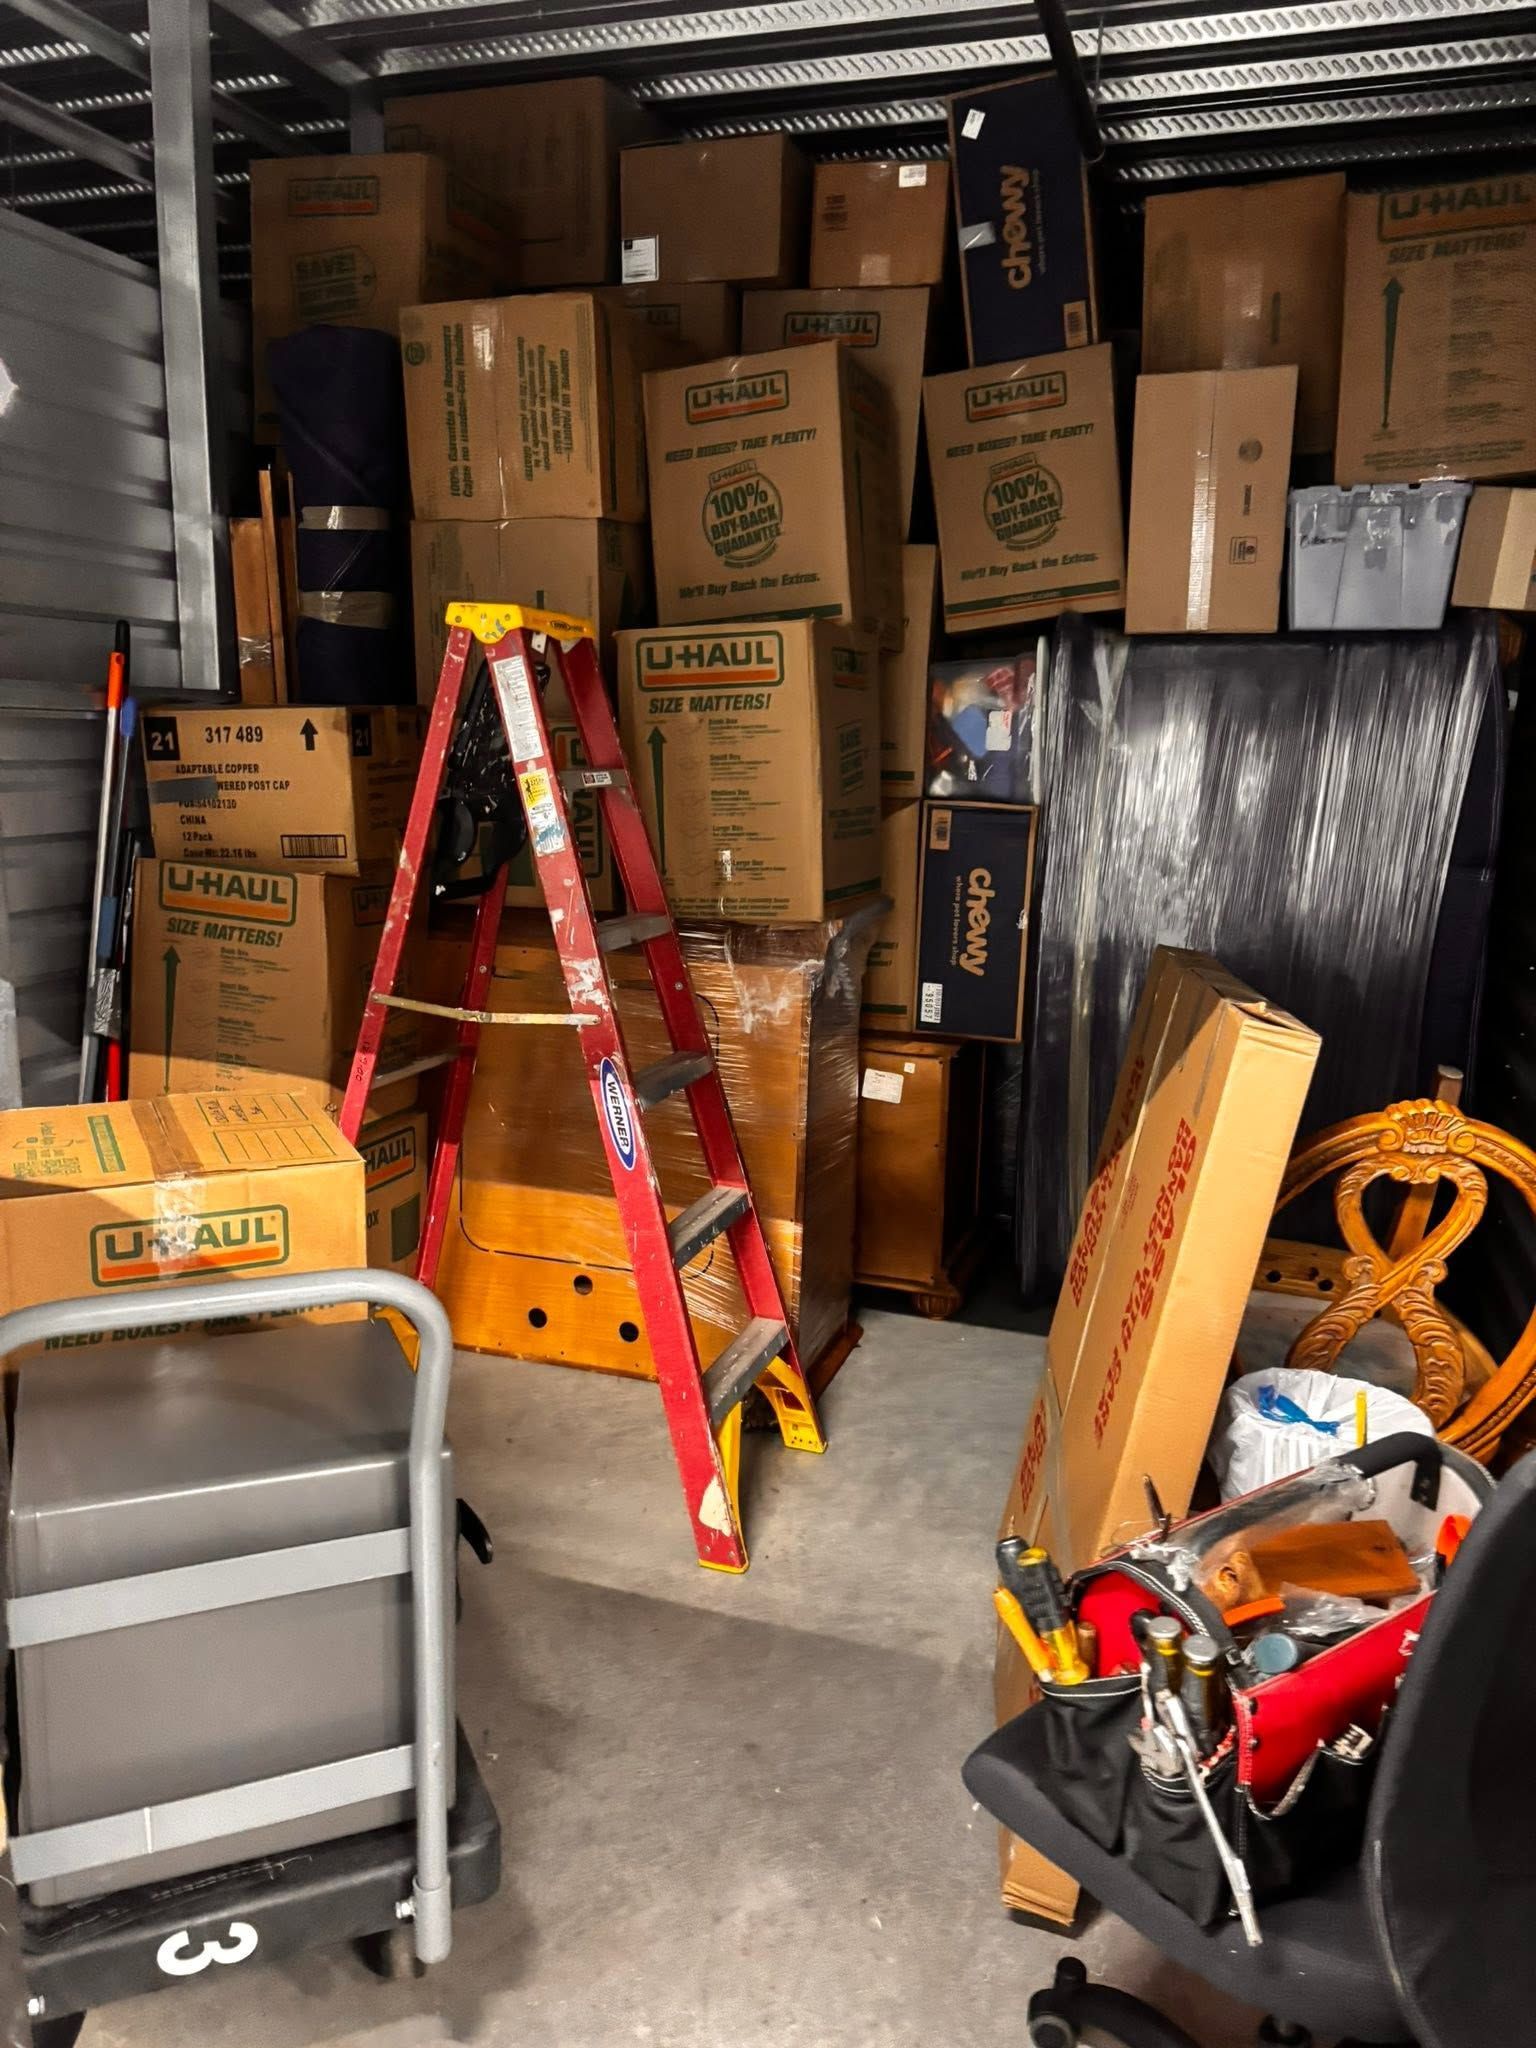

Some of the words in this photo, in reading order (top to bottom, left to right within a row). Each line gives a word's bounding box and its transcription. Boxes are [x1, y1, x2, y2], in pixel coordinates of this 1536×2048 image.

[999, 164, 1033, 289] chewy
[791, 312, 876, 335] U-HAUL
[444, 392, 453, 407] de
[692, 378, 783, 410] U-HAUL
[972, 378, 1060, 408] U-HAUL
[741, 436, 768, 451] TAKE
[771, 427, 817, 446] PLENTY!
[1021, 430, 1047, 445] TAKE
[1050, 423, 1094, 440] PLENTY!
[461, 447, 470, 461] no
[450, 466, 461, 498] 100%
[463, 467, 473, 499] Cajas
[991, 471, 1048, 507] 100%
[710, 480, 769, 518] 100%
[991, 493, 1058, 525] BUY-BACK
[710, 503, 778, 540] BUY-BACK
[996, 511, 1063, 542] GUARANTEE
[715, 524, 782, 557] GUARANTEE
[988, 564, 1008, 578] Buy
[1011, 560, 1038, 573] Back
[1041, 558, 1058, 571] the
[707, 581, 728, 597] Buy
[730, 577, 757, 593] Back
[760, 575, 778, 590] the
[782, 571, 821, 587] Extras.
[646, 640, 774, 670] U-HAUL
[649, 697, 683, 714] SIZE
[689, 692, 772, 713] MATTERS!
[151, 731, 175, 751] 21
[205, 727, 232, 744] 317
[235, 726, 263, 743] 489
[354, 728, 370, 747] 21
[176, 764, 223, 775] ADAPTABLE
[225, 763, 259, 774] COPPER
[217, 781, 246, 791] WERED
[248, 780, 270, 791] POST
[272, 780, 290, 790] CAP
[180, 815, 206, 825] CHINA
[182, 831, 192, 841] 12
[193, 832, 213, 841] Pack
[244, 848, 256, 858] lbs
[169, 867, 287, 905] U-HAUL
[953, 875, 963, 902] where
[952, 903, 961, 917] pet
[959, 867, 996, 977] chewy
[167, 917, 199, 936] SIZE
[203, 922, 283, 948] MATTERS!
[951, 919, 961, 945] lovers
[950, 946, 960, 966] shop
[607, 1081, 629, 1147] WERNER
[366, 1137, 411, 1173] HAUL
[1168, 1117, 1184, 1173] DO
[1152, 1123, 1190, 1262] HANDLE
[367, 1209, 379, 1229] OX
[1139, 1136, 1195, 1320] GLASS
[1143, 1184, 1165, 1261] NOT
[1121, 1269, 1140, 1335] LAY
[1122, 1267, 1150, 1352] WITH
[156, 1922, 258, 1976] 3
